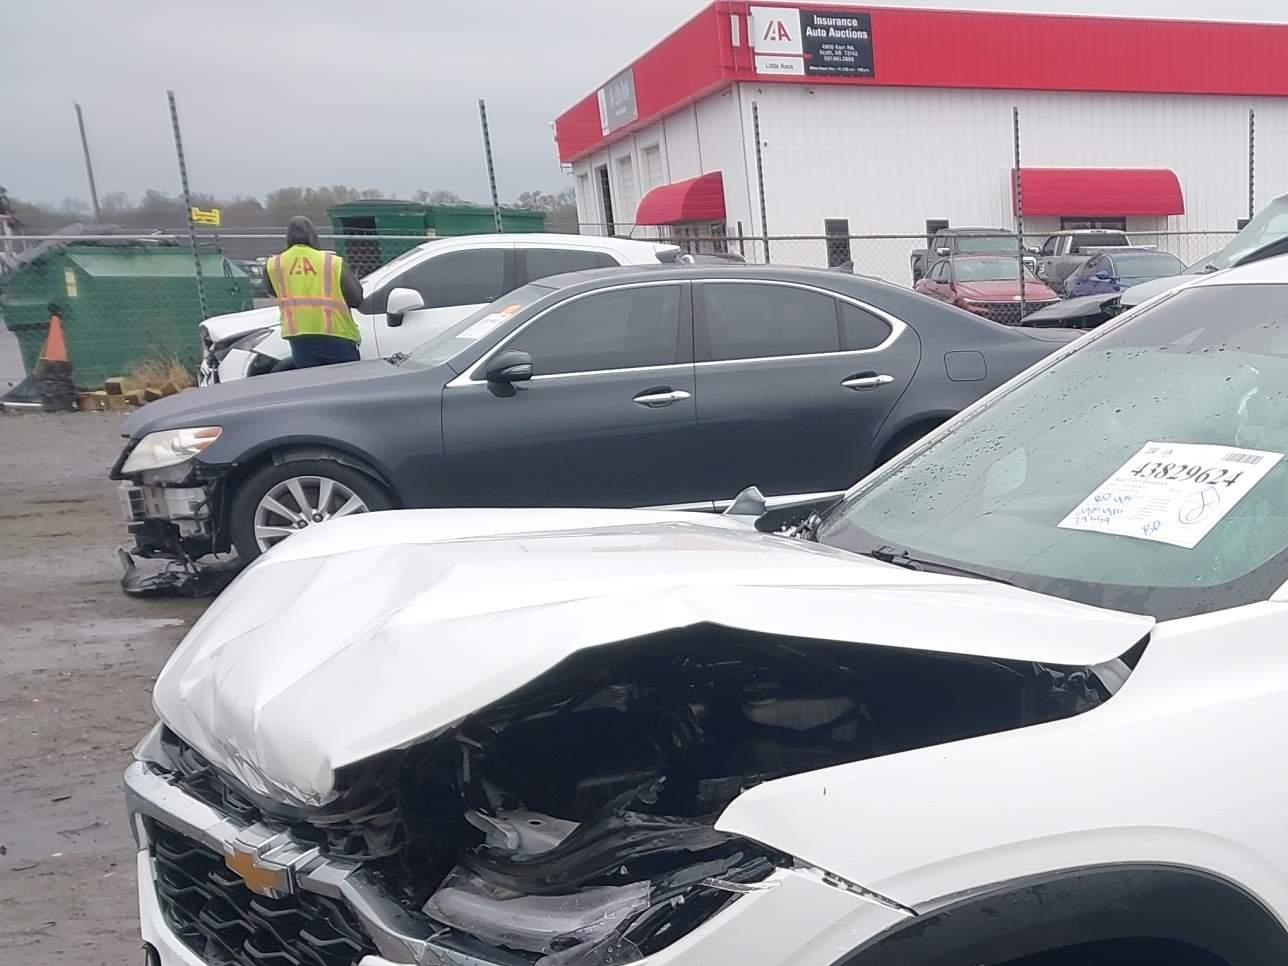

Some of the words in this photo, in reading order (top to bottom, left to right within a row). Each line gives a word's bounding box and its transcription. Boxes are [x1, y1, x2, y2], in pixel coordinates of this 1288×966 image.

[813, 14, 858, 26] Insurance
[805, 26, 827, 37] Auto
[828, 27, 868, 39] Auctions
[1130, 461, 1244, 488] 43829624
